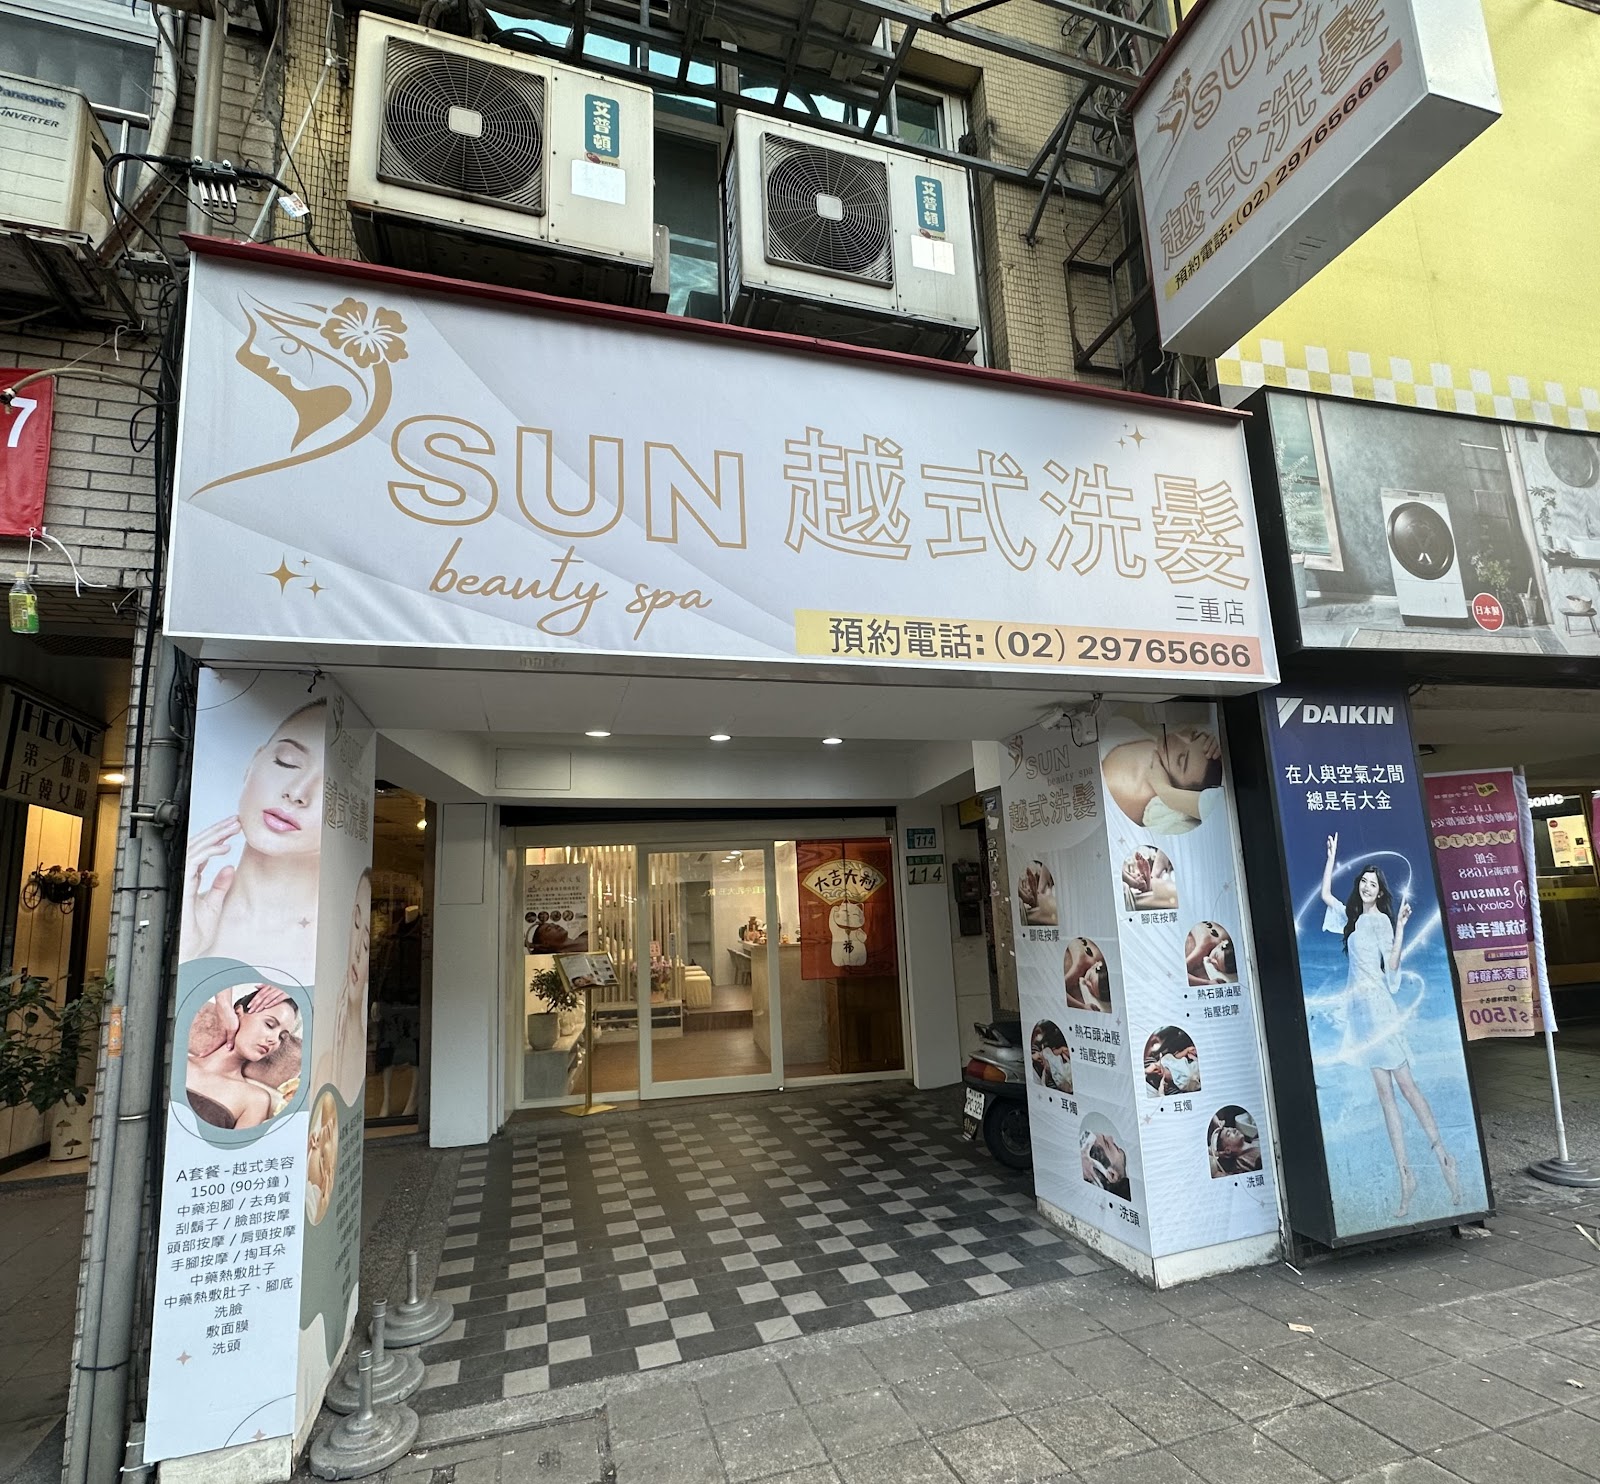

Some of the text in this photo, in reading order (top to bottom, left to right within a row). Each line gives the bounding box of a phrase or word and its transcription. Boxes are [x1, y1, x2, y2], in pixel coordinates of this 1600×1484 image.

[0, 109, 60, 128] INVERTER
[593, 100, 611, 153] 艾普頓
[1160, 0, 1390, 271] 越式洗髮
[1236, 181, 1271, 225] (02)
[1275, 60, 1389, 187] 29765666
[7, 397, 37, 447] 7
[387, 414, 748, 549] SUN
[783, 426, 1250, 591] 越式洗髮
[429, 537, 713, 641] beauty spa
[1173, 594, 1246, 627] 三重店
[1475, 605, 1500, 616] 日本製
[828, 616, 1252, 669] 預約電話: (02) 29765666
[1302, 704, 1394, 725] DAIKIN
[1025, 744, 1070, 780] SUN
[1284, 764, 1405, 785] 在人與空氣之間
[1008, 781, 1097, 833] 越式洗髮
[1306, 790, 1392, 811] 總是有大金
[916, 835, 934, 847] 114
[814, 869, 876, 892] 大吉大利
[909, 866, 942, 883] 114
[1141, 912, 1178, 925] 腳底按摩
[1197, 986, 1242, 1001] 熱石頭油壓
[1204, 1004, 1240, 1018] 指壓按摩
[1074, 1023, 1121, 1046] 熱石頭油壓
[1079, 1046, 1117, 1067] 指壓按摩
[191, 1183, 225, 1198] 1500
[1246, 1175, 1265, 1188] 洗頭
[177, 1199, 234, 1217] 中藥泡腳
[250, 1191, 291, 1208] 去角質
[1119, 1203, 1141, 1228] 洗頭
[234, 1208, 290, 1227] 臉部按摩
[167, 1235, 225, 1255] 頭部按摩
[241, 1225, 296, 1244] 肩頸按摩
[170, 1252, 229, 1272] 手腳按摩
[244, 1243, 286, 1261] 掏耳朵
[190, 1262, 275, 1287] 中藥熱敷肚子
[214, 1302, 243, 1319] 洗臉
[205, 1319, 249, 1339] 敷面膜
[212, 1338, 241, 1355] 洗頭
